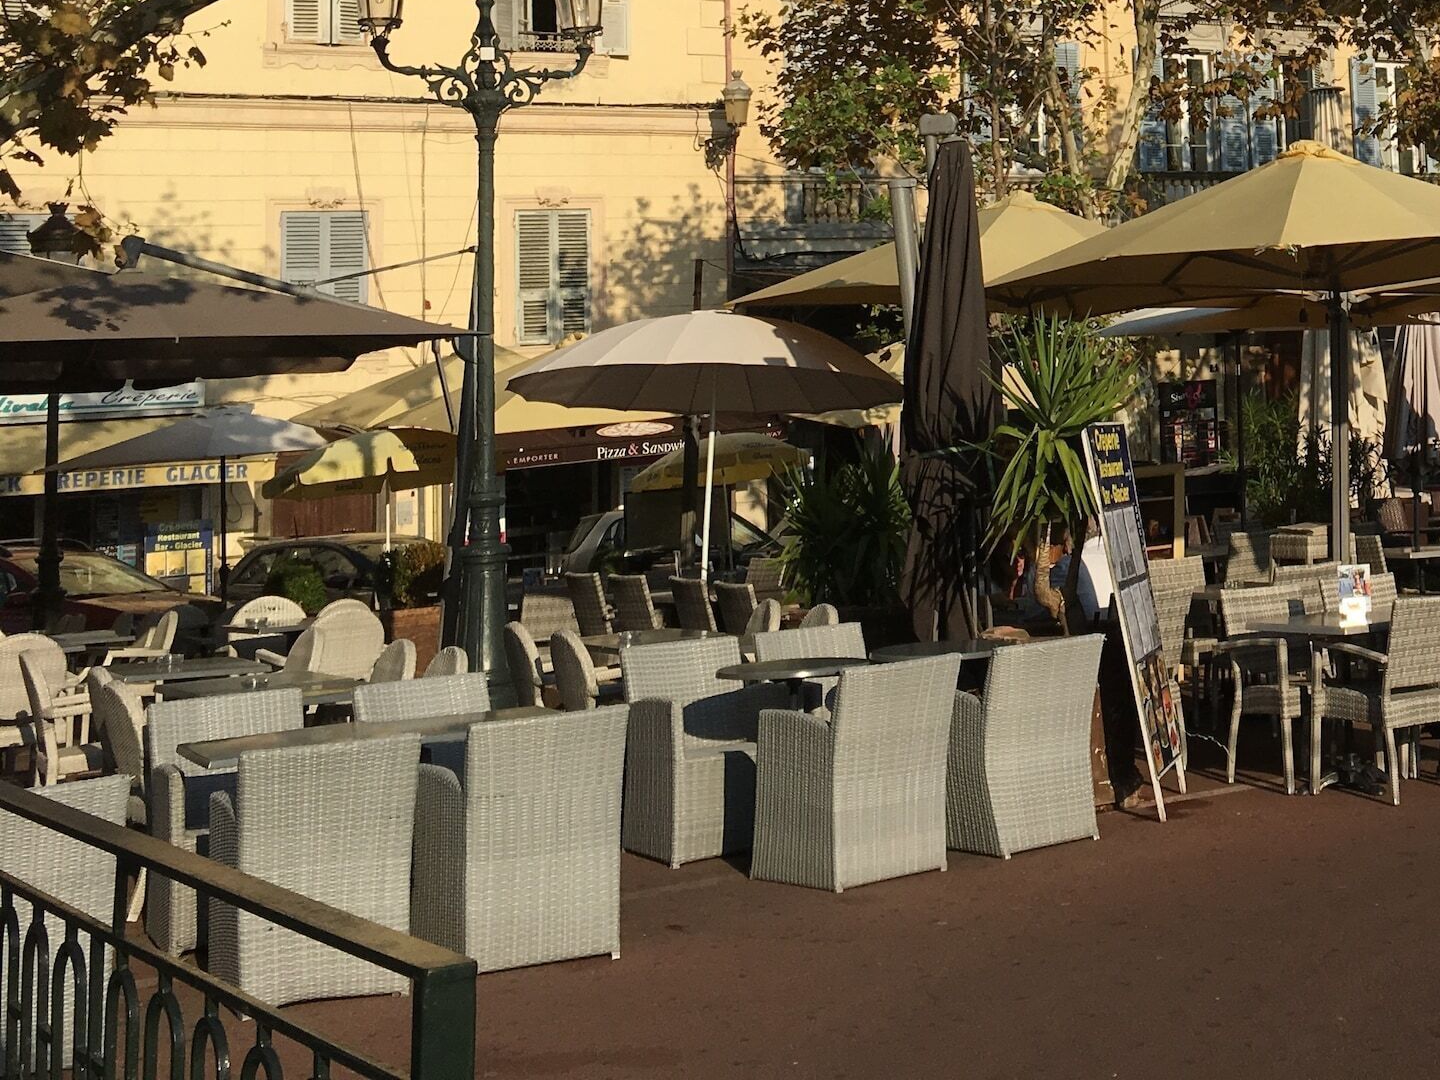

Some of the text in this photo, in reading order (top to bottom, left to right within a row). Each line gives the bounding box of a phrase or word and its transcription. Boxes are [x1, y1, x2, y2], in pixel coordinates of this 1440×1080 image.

[597, 446, 627, 460] Pizza
[627, 443, 639, 455] &
[57, 469, 146, 490] REPERIE
[157, 531, 200, 542] Restaurant
[154, 543, 168, 551] Bar
[175, 541, 203, 550] Glacier
